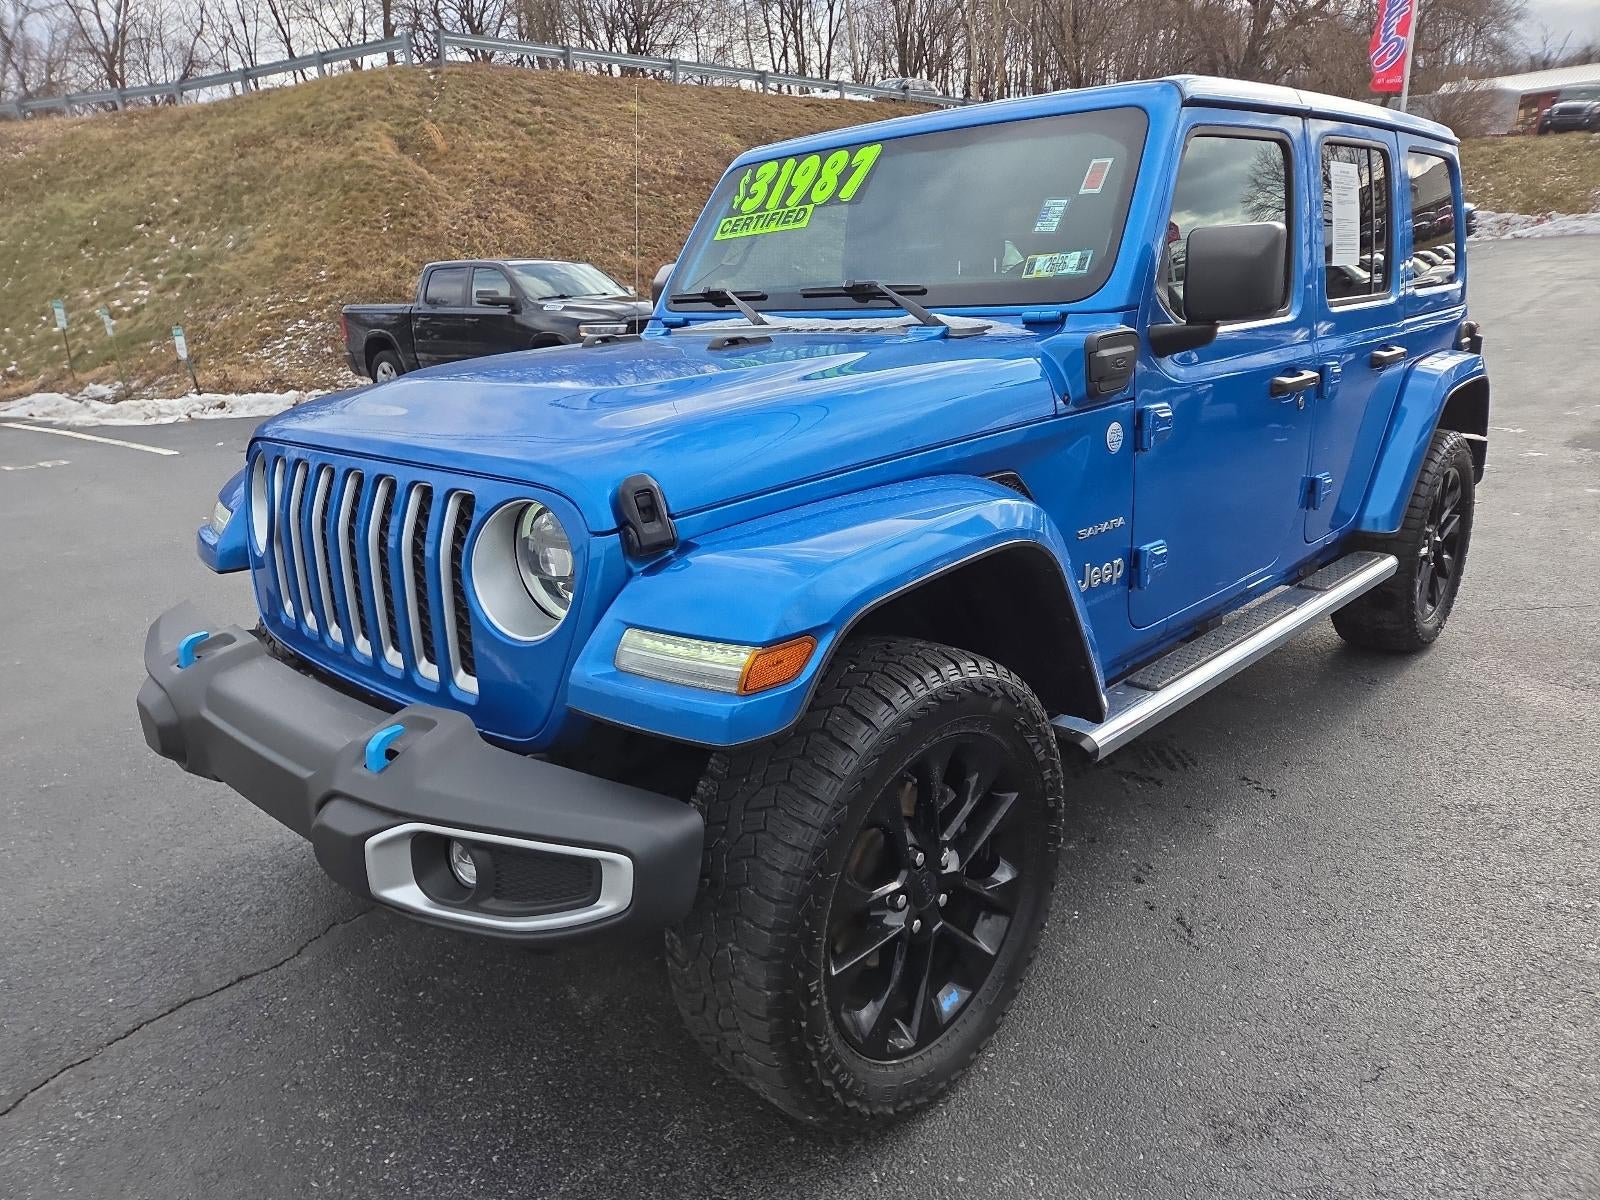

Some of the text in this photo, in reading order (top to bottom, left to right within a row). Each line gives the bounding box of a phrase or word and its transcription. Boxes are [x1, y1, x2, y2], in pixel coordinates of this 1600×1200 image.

[733, 143, 883, 213] $31987
[719, 207, 809, 235] CERTIFIED
[1076, 516, 1126, 540] SAHARA
[1077, 557, 1125, 592] Jeep
